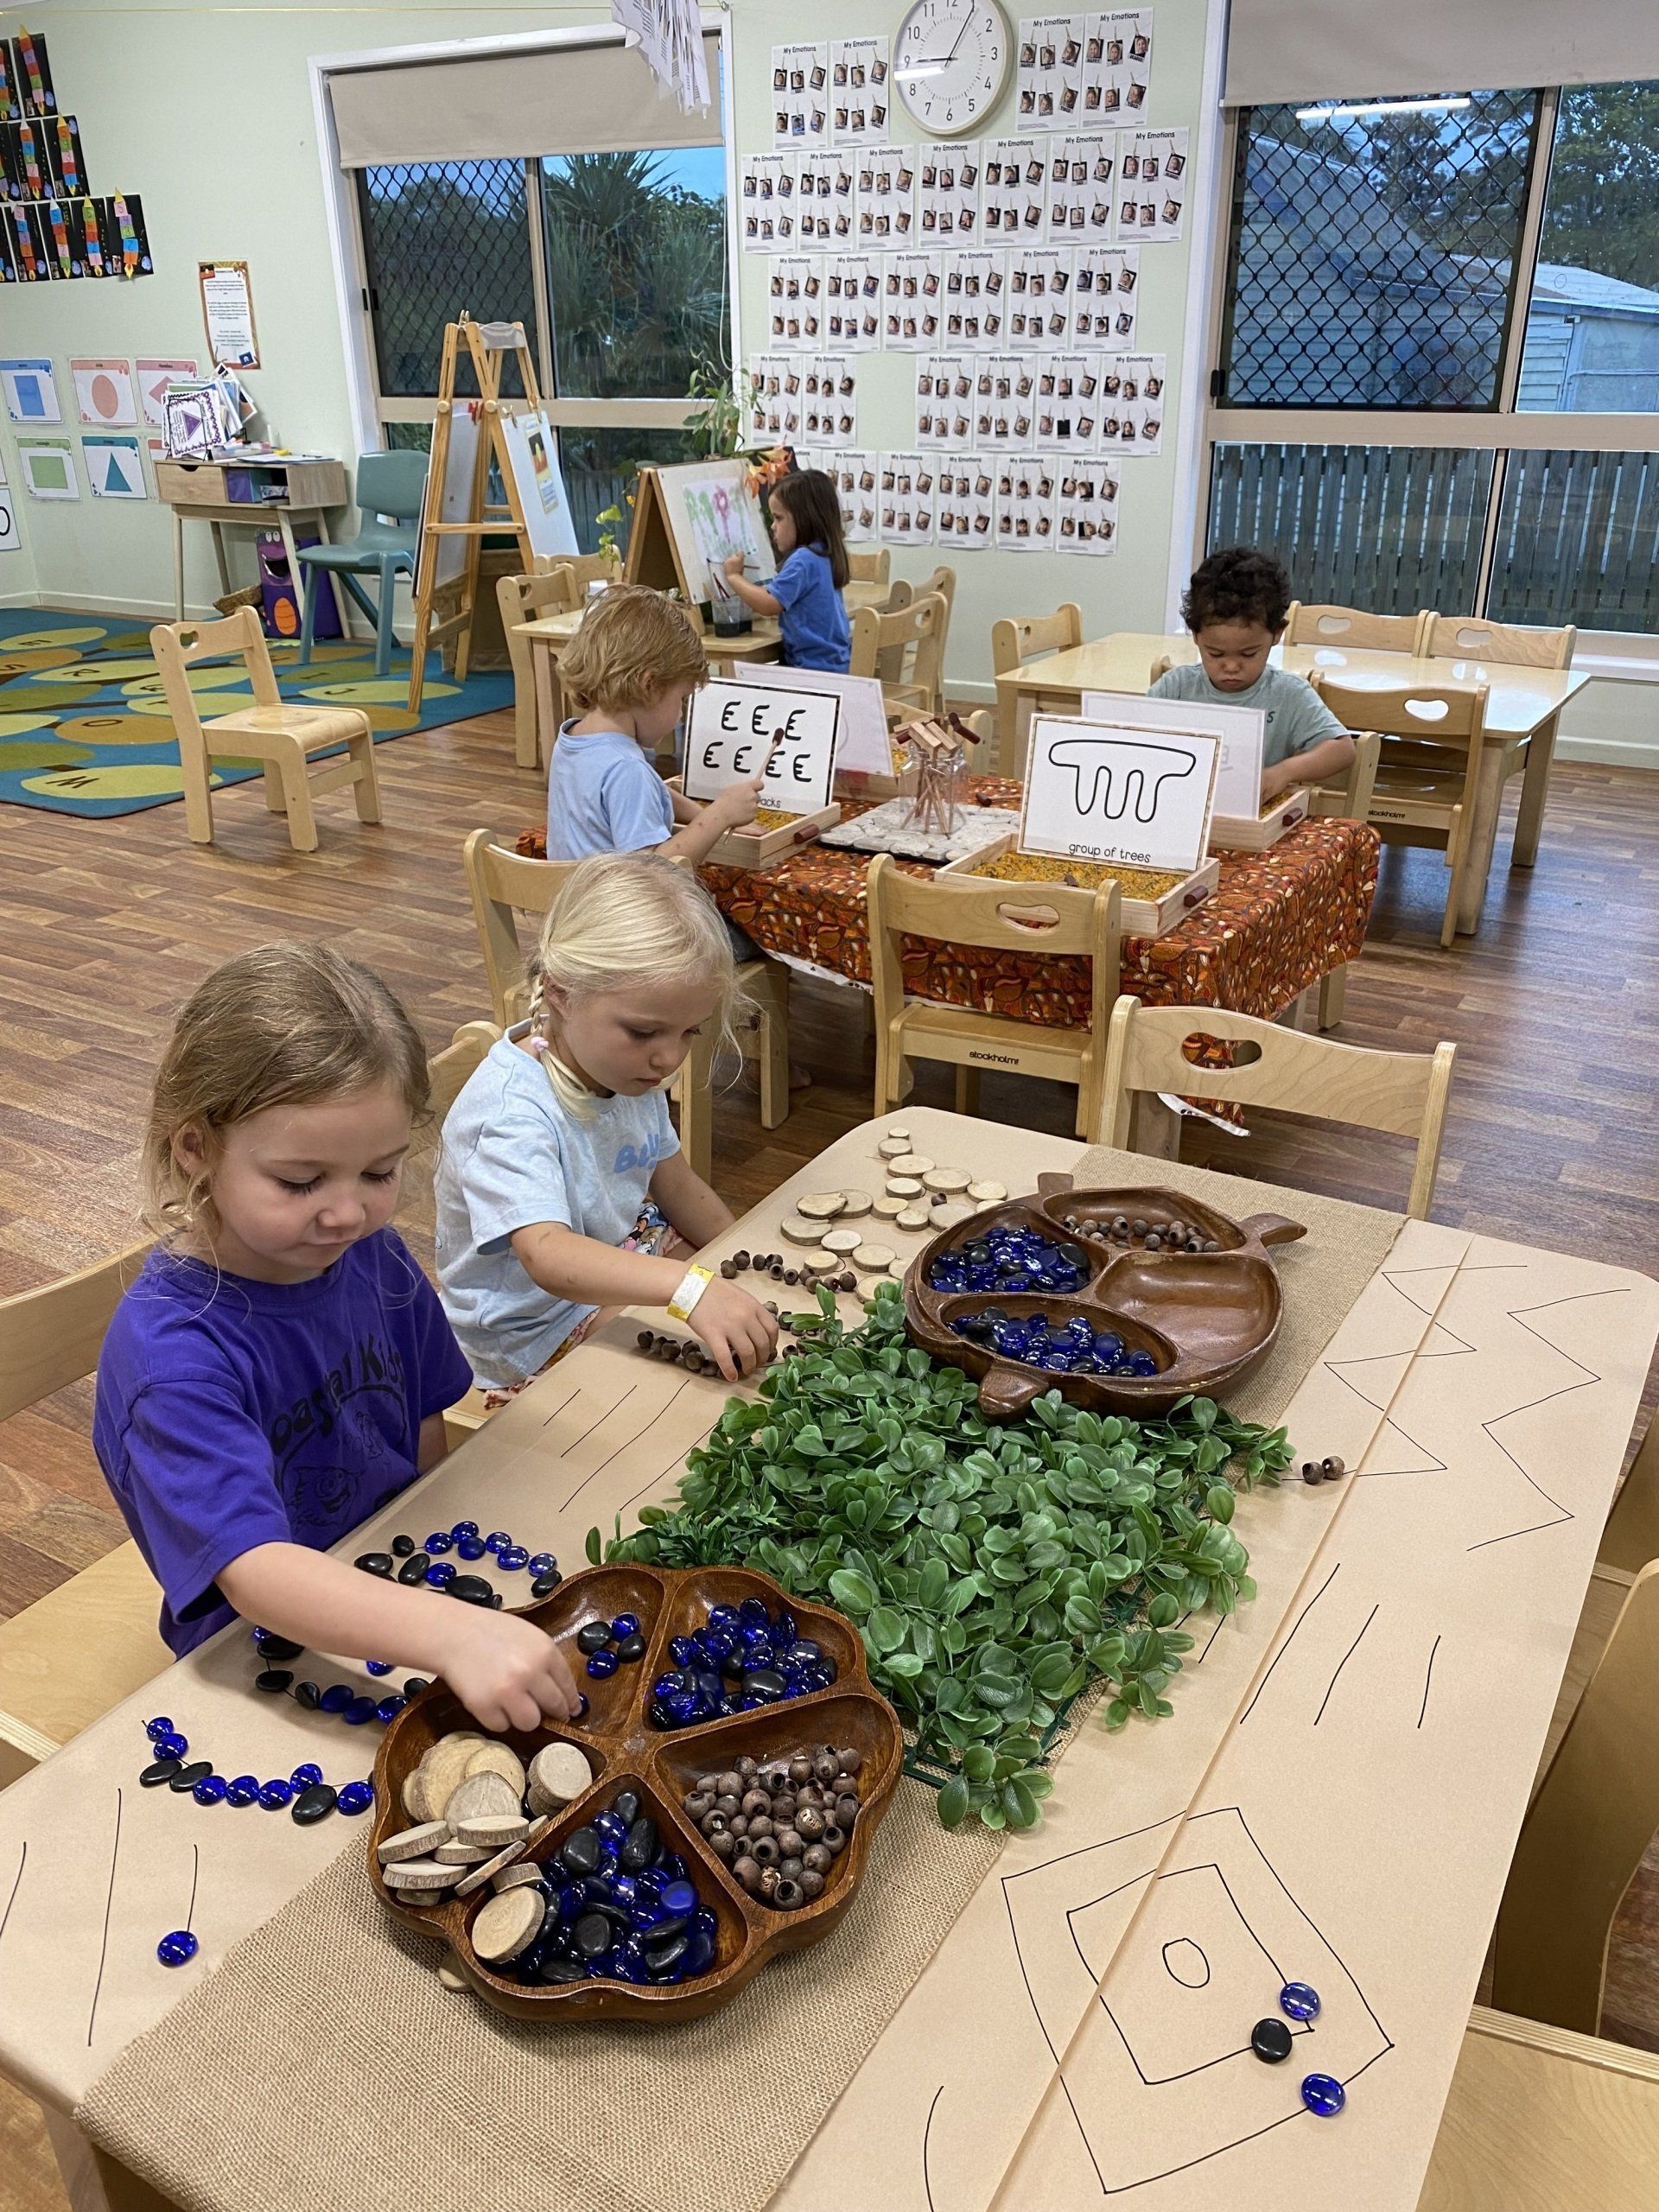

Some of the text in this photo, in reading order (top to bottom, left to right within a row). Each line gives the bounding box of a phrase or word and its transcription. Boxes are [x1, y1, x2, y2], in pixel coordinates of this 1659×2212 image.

[924, 3, 934, 17] 11
[986, 18, 993, 32] 2
[907, 26, 920, 40] 10
[991, 47, 998, 60] 3
[904, 55, 911, 68] 9
[984, 76, 991, 89] 4
[909, 83, 916, 96] 8
[925, 102, 931, 115] 7
[968, 99, 975, 111] 5
[946, 108, 952, 121] 6
[760, 798, 781, 809] acks
[1068, 843, 1151, 863] group of trees
